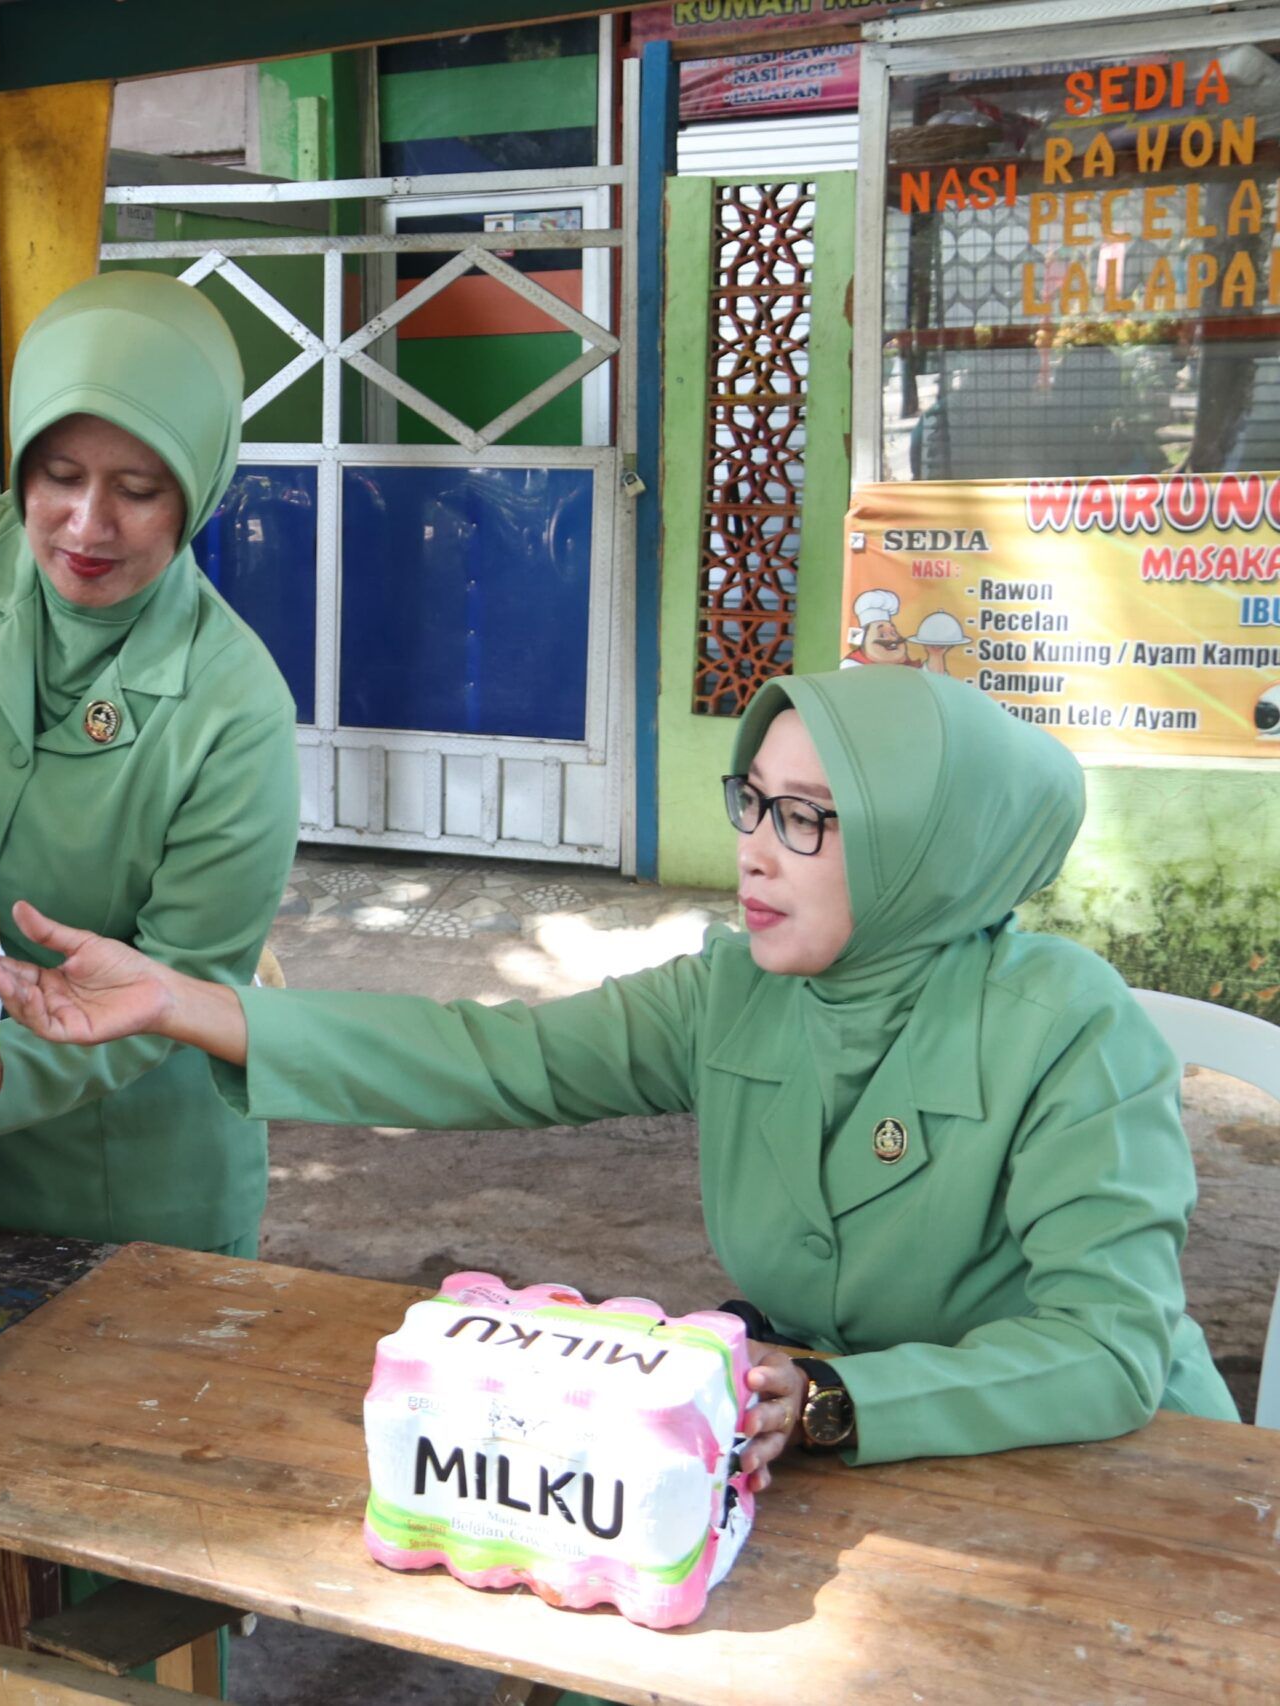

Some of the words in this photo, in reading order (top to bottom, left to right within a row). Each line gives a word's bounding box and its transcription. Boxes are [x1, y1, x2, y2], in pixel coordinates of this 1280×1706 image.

[733, 67, 779, 84] NASI
[1064, 58, 1230, 116] SEDIA
[901, 164, 1017, 215] NASI
[1029, 177, 1280, 246] PECELA
[884, 529, 989, 552] SEDIA
[980, 579, 1053, 601] Rawon
[980, 609, 1069, 632] Pecelan
[978, 639, 1027, 662] Soto
[1032, 641, 1112, 665] Kuning
[1133, 643, 1197, 667] Ayam
[978, 670, 1065, 694] Campur
[1001, 702, 1061, 726] apan
[1067, 704, 1112, 727] Lele
[1134, 707, 1197, 730] Ayam
[445, 1316, 668, 1375] MILKU
[414, 1436, 624, 1539] MILKU
[451, 1516, 505, 1540] Belgian
